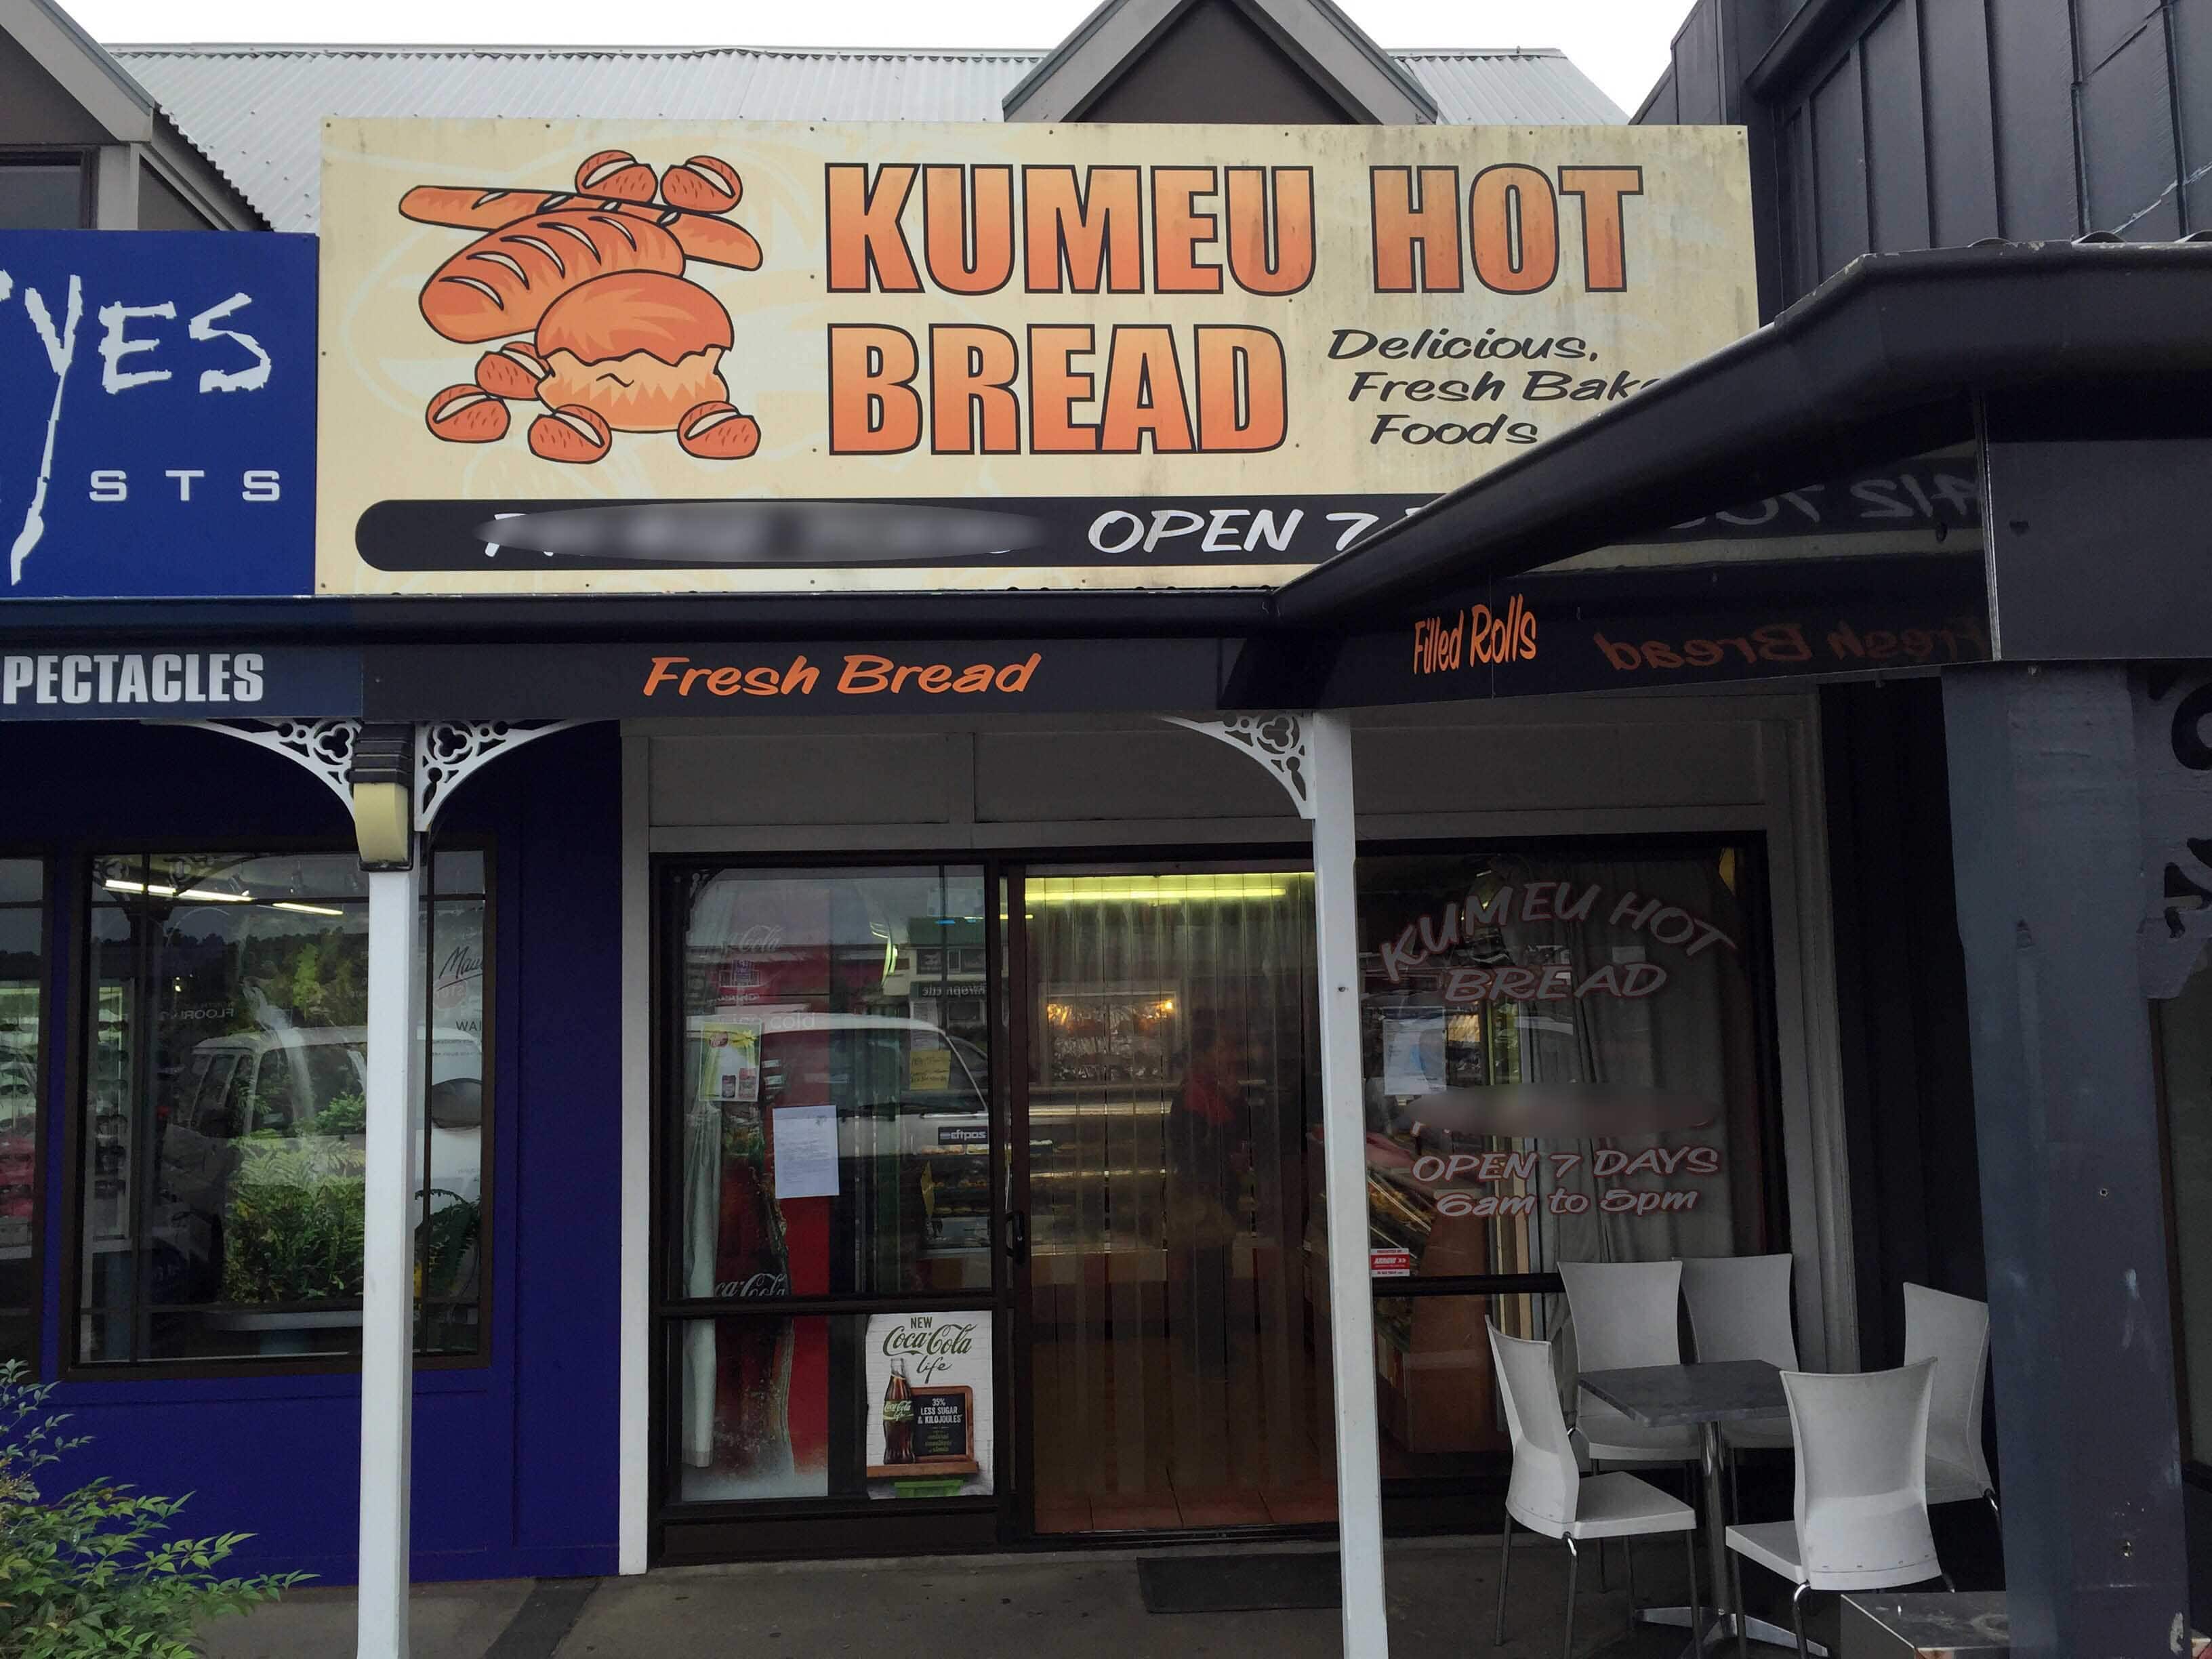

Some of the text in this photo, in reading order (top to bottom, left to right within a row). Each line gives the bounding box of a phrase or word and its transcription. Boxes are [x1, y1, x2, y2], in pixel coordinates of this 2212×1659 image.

[825, 163, 1643, 296] KUMEU HOT
[1327, 328, 1598, 361] Delicious,
[827, 323, 1288, 455] BREAD
[1347, 370, 1660, 403] Fresh Bak
[0, 268, 271, 586] YES
[1369, 413, 1538, 445] Foods
[1088, 509, 1379, 554] OPEN 7
[1414, 594, 1537, 675] Filled Rolls
[3, 653, 264, 704] PECTACLES
[643, 653, 1042, 697] Fresh Bread
[1380, 881, 1738, 981] KUMEU HOT
[1445, 962, 1667, 1003] BREAD
[770, 1013, 815, 1028] cold
[1412, 1147, 1719, 1183] OPEN 7 DAYS
[1437, 1188, 1698, 1217] 6am to 5pm
[910, 1317, 933, 1329] NEW
[916, 1356, 953, 1383] life
[920, 1406, 958, 1415] LESS SUGAR
[932, 1398, 946, 1406] 35%
